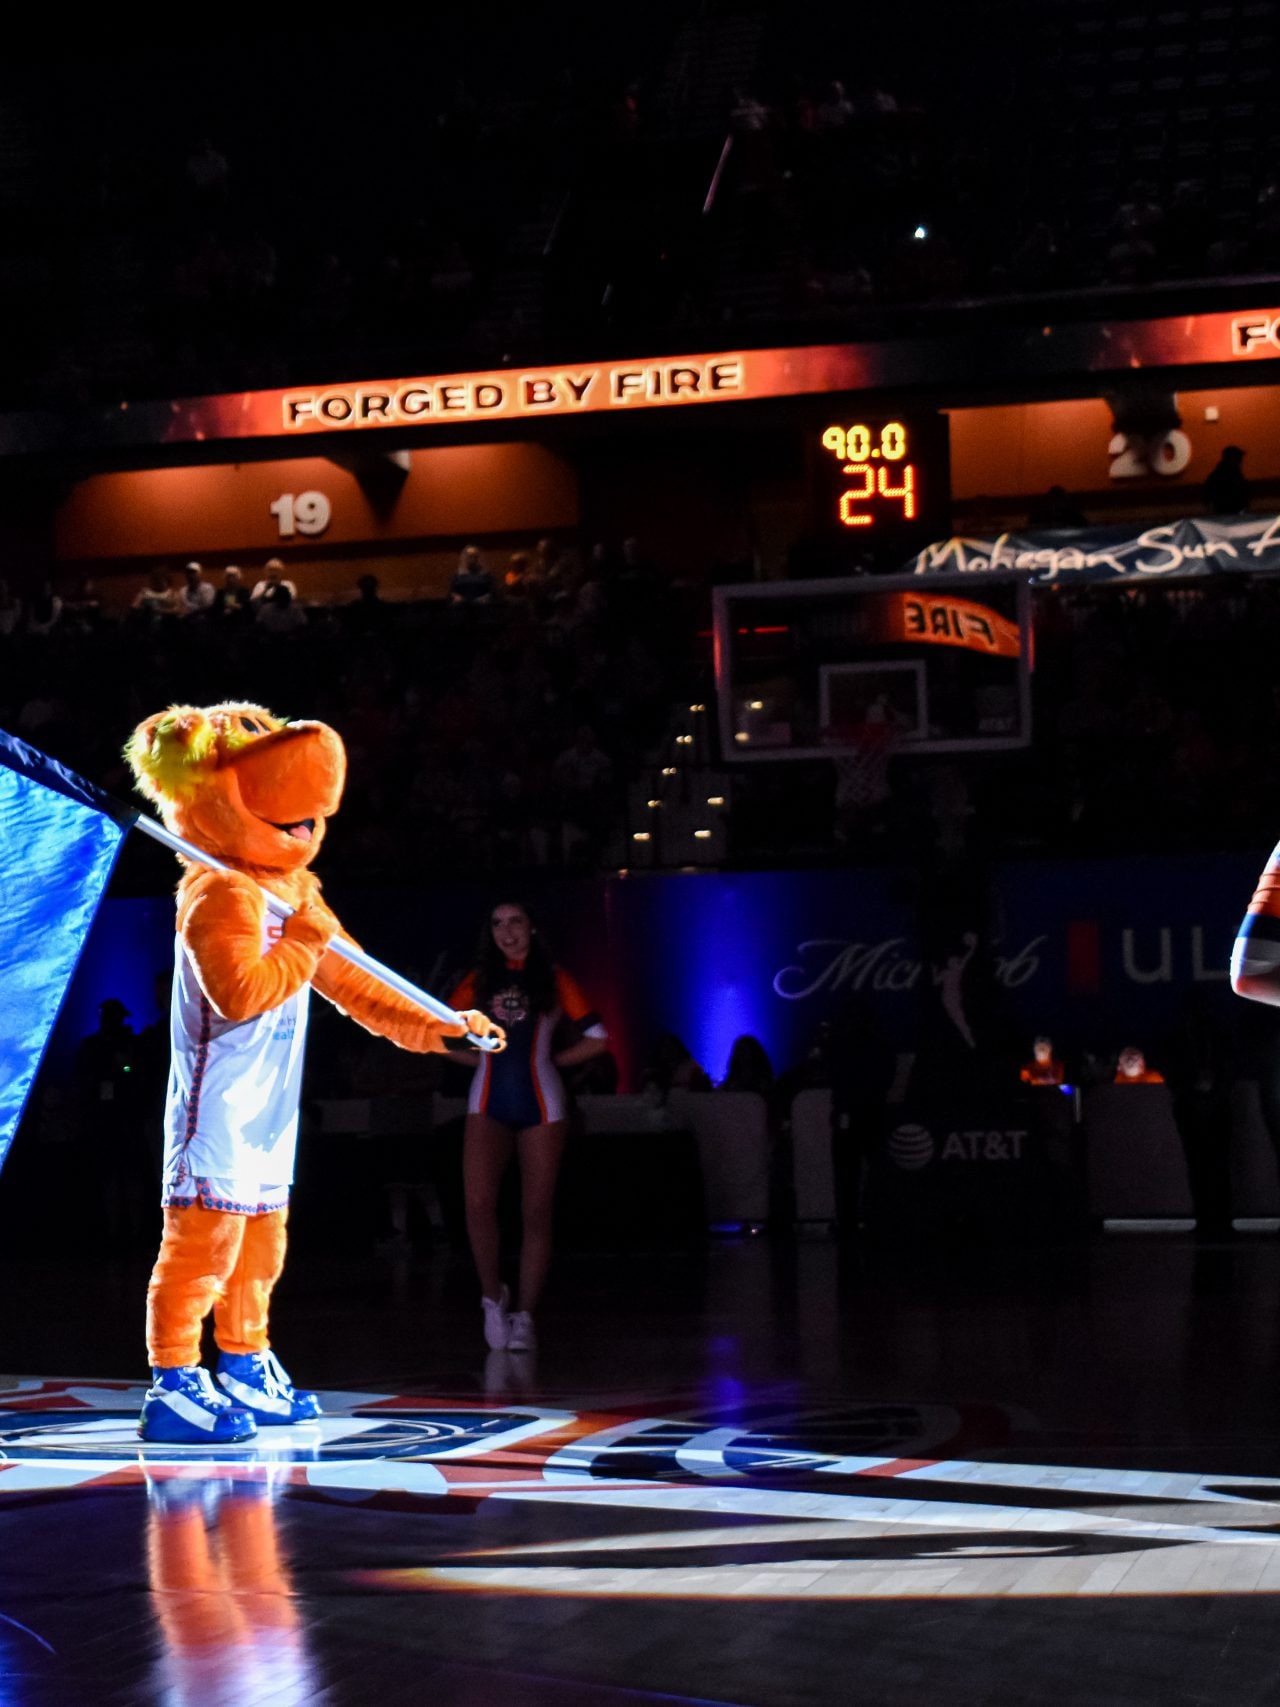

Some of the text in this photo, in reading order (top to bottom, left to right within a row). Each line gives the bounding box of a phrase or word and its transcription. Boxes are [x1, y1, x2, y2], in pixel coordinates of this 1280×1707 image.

[1232, 316, 1280, 356] F
[283, 357, 744, 429] FORGED BY FIRE
[822, 423, 906, 462] 90.0
[1108, 427, 1192, 479] 20
[270, 491, 331, 536] 19
[839, 464, 915, 526] 24
[914, 532, 1126, 580] Mohegan
[1135, 525, 1239, 574] Sun
[940, 1129, 1030, 1161] AT&T
